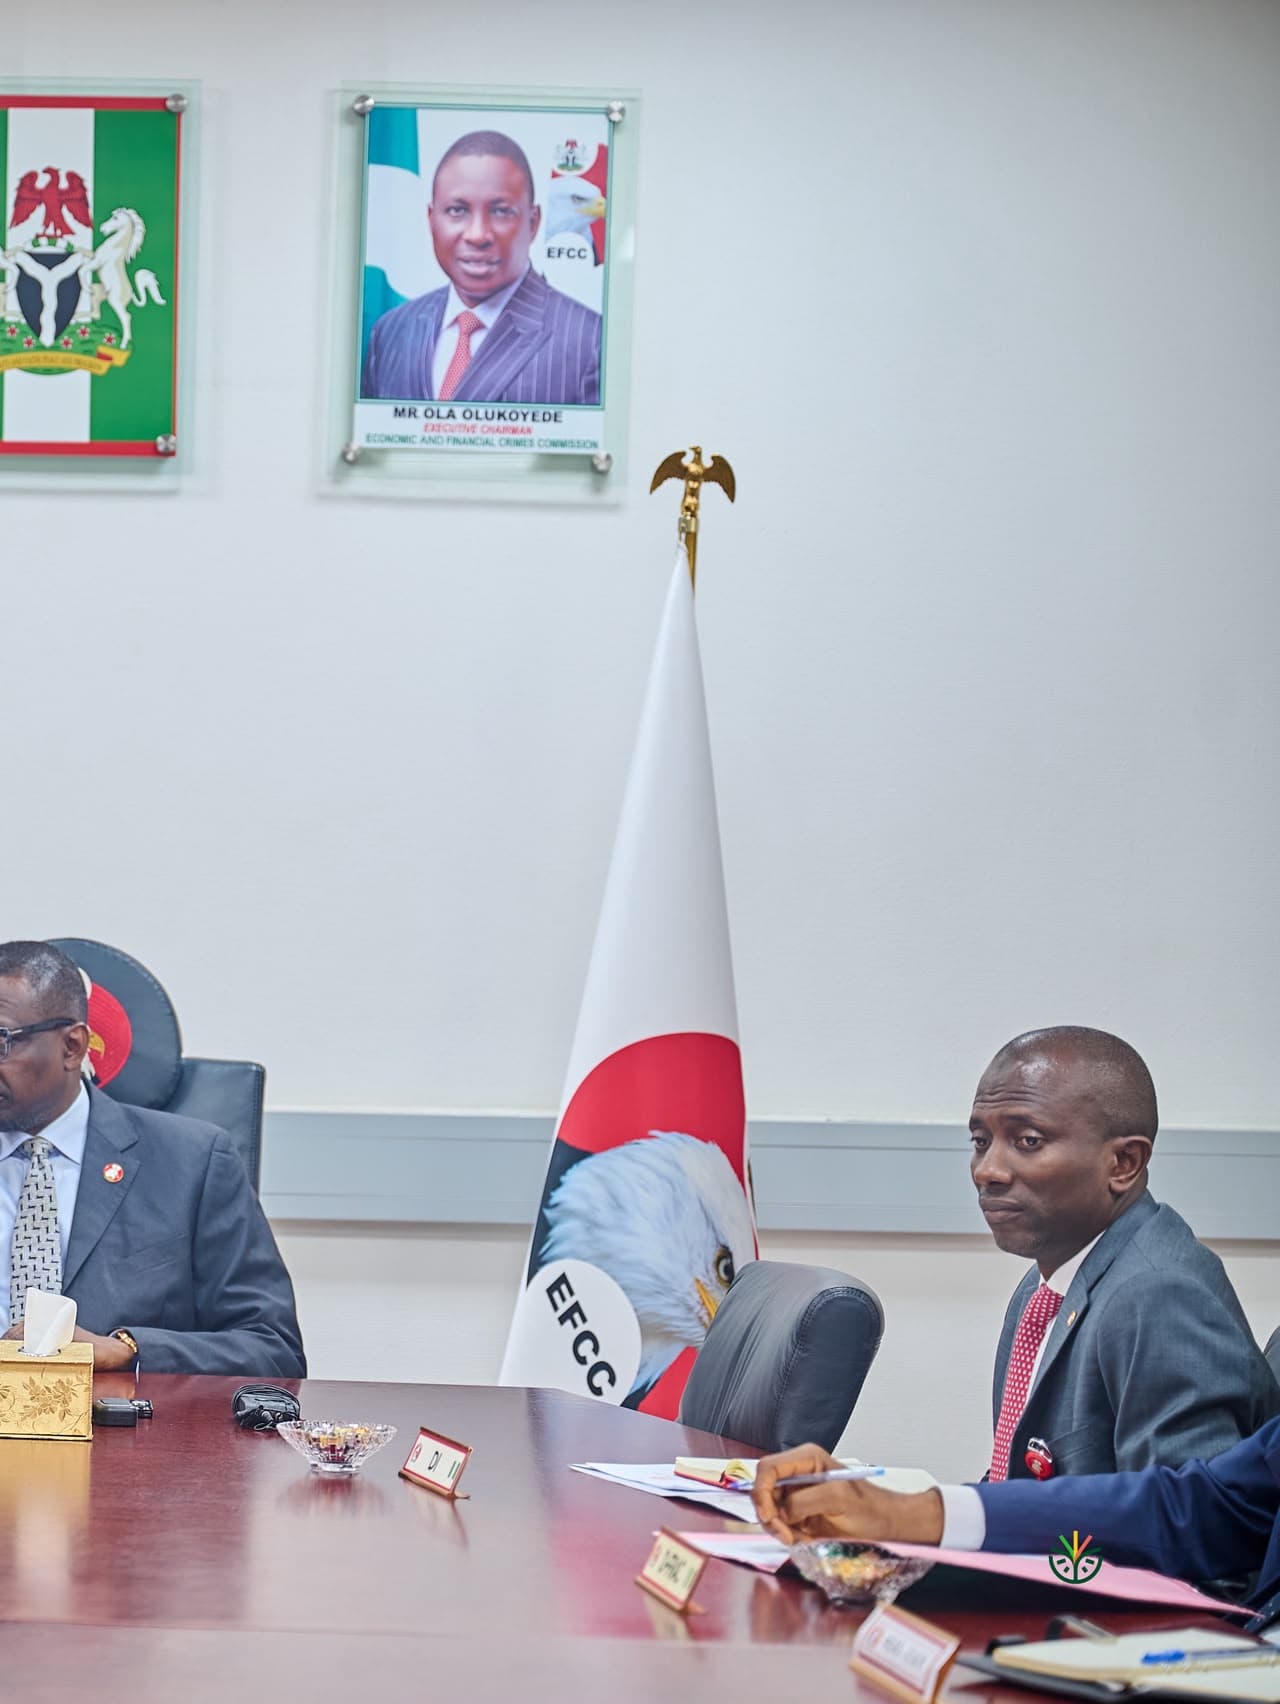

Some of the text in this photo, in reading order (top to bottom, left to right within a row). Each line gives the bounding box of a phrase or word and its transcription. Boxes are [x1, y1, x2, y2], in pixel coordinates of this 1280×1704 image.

[547, 247, 588, 259] EFCC
[424, 407, 456, 420] OLA
[462, 408, 563, 423] OLUKOYEDE
[423, 423, 533, 435] EXECUTIVE CHAIRMAN
[366, 433, 598, 450] ECONOMIC AND FINANCIAL CRIMES COMMISSION
[546, 1271, 617, 1397] EFCC
